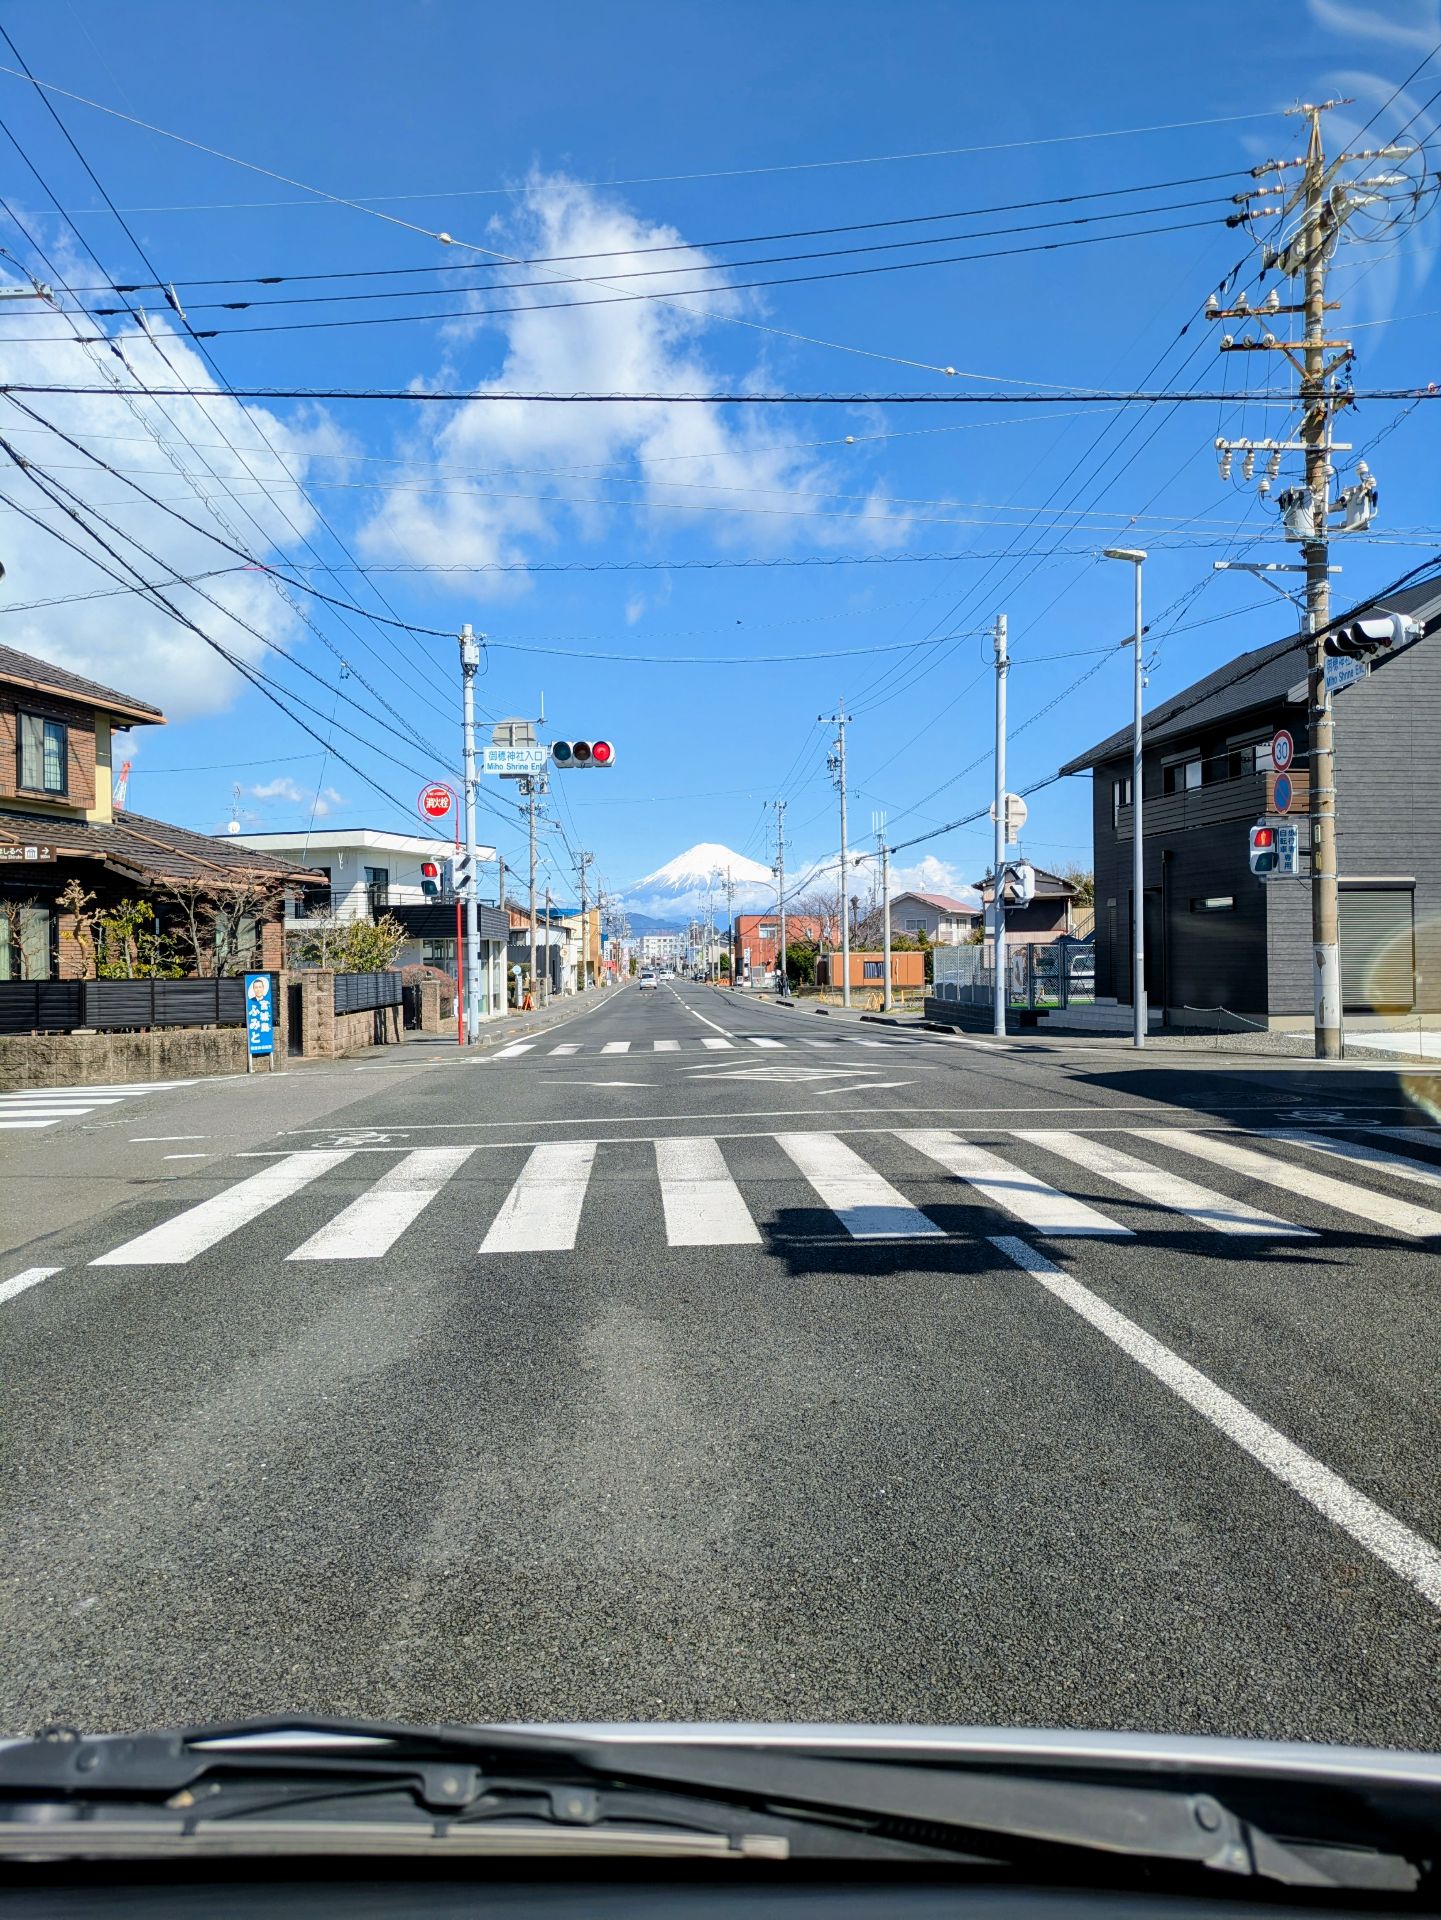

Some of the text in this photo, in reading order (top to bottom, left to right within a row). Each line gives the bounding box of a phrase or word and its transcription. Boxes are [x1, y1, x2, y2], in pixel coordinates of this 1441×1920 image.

[1339, 669, 1354, 683] Shrine
[489, 751, 542, 761] 御穂神社入口
[1276, 742, 1288, 761] 30
[426, 797, 449, 808] 消火栓
[1287, 829, 1296, 853] 歩行者
[249, 1004, 261, 1044] ふみと
